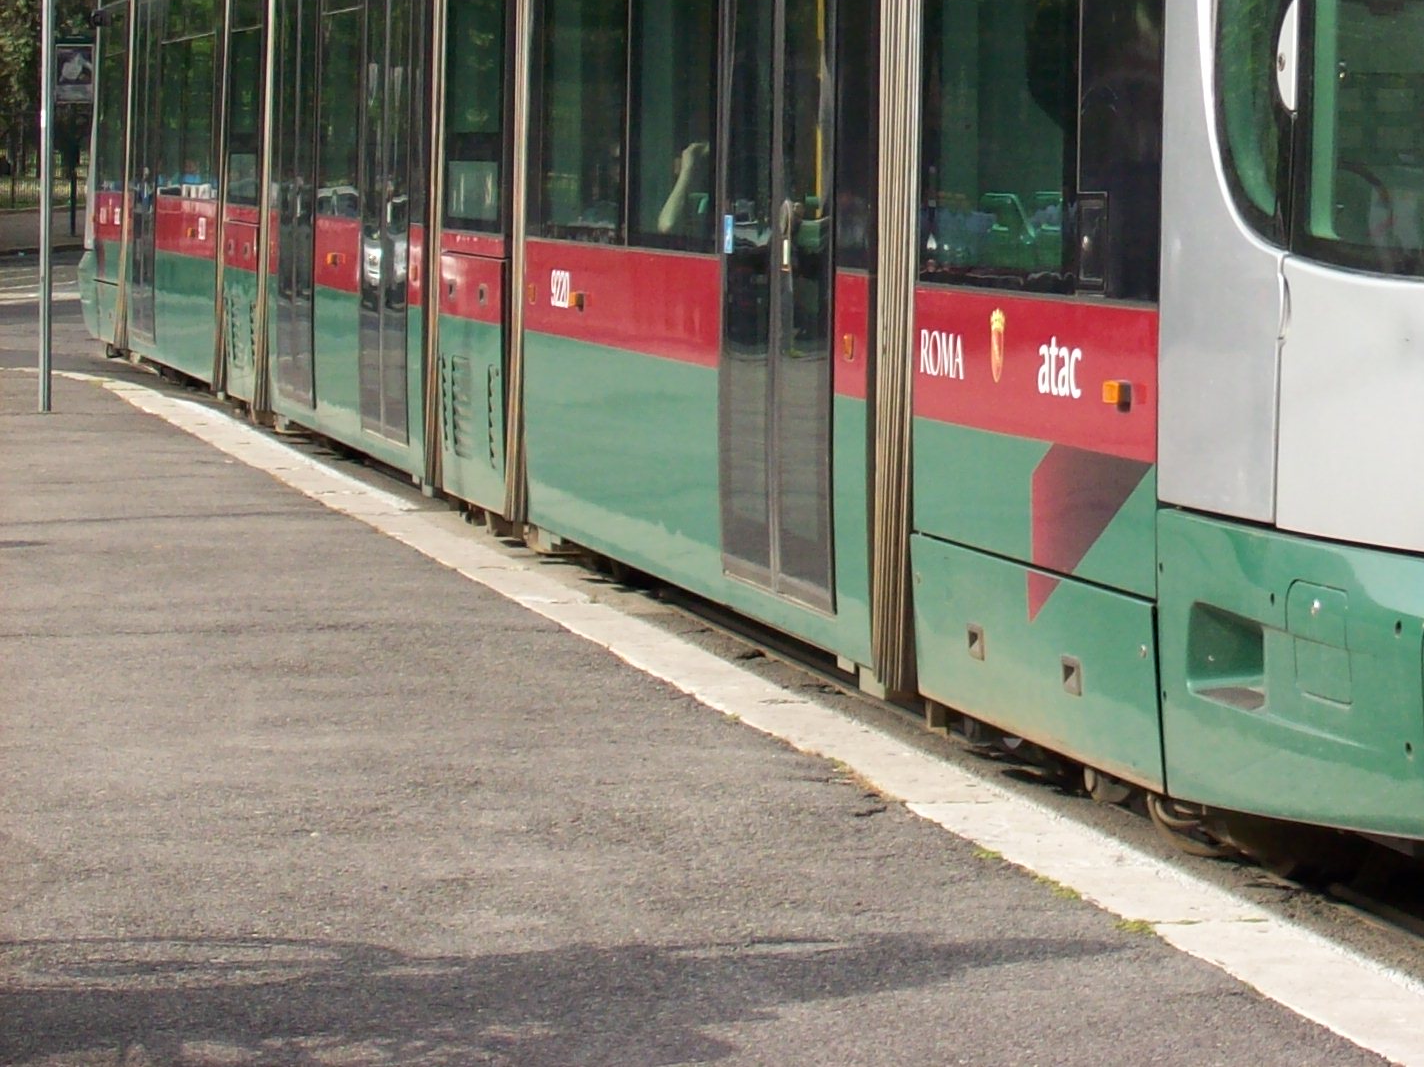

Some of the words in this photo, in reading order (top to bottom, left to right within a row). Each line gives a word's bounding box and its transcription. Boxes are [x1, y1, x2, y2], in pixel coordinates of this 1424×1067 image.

[550, 269, 571, 309] 9220
[919, 329, 964, 380] ROMA
[1037, 335, 1082, 399] atac
